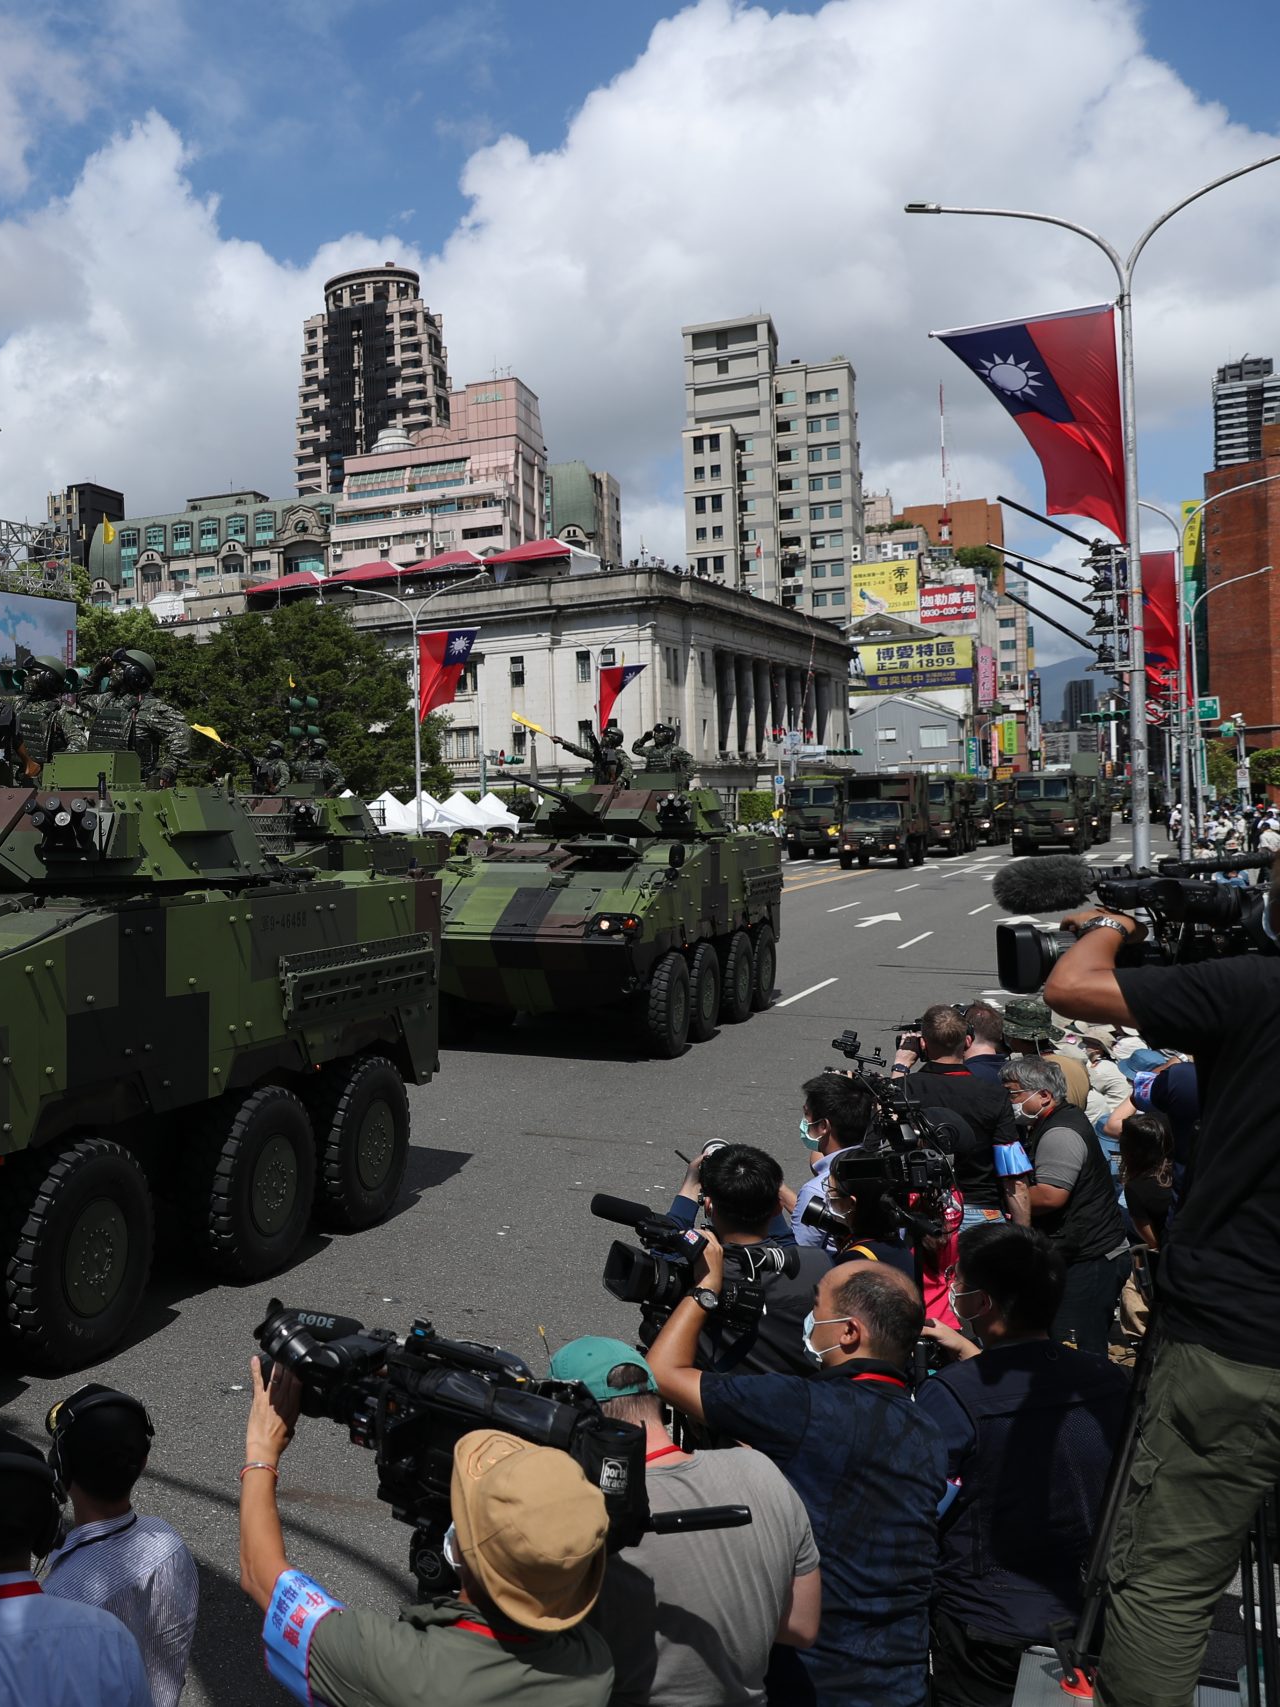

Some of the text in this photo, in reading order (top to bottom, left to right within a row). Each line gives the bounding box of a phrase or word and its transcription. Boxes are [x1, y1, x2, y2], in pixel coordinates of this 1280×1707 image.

[876, 641, 955, 661] 博愛特區
[917, 657, 955, 668] 1899
[297, 1312, 336, 1329] RØDE
